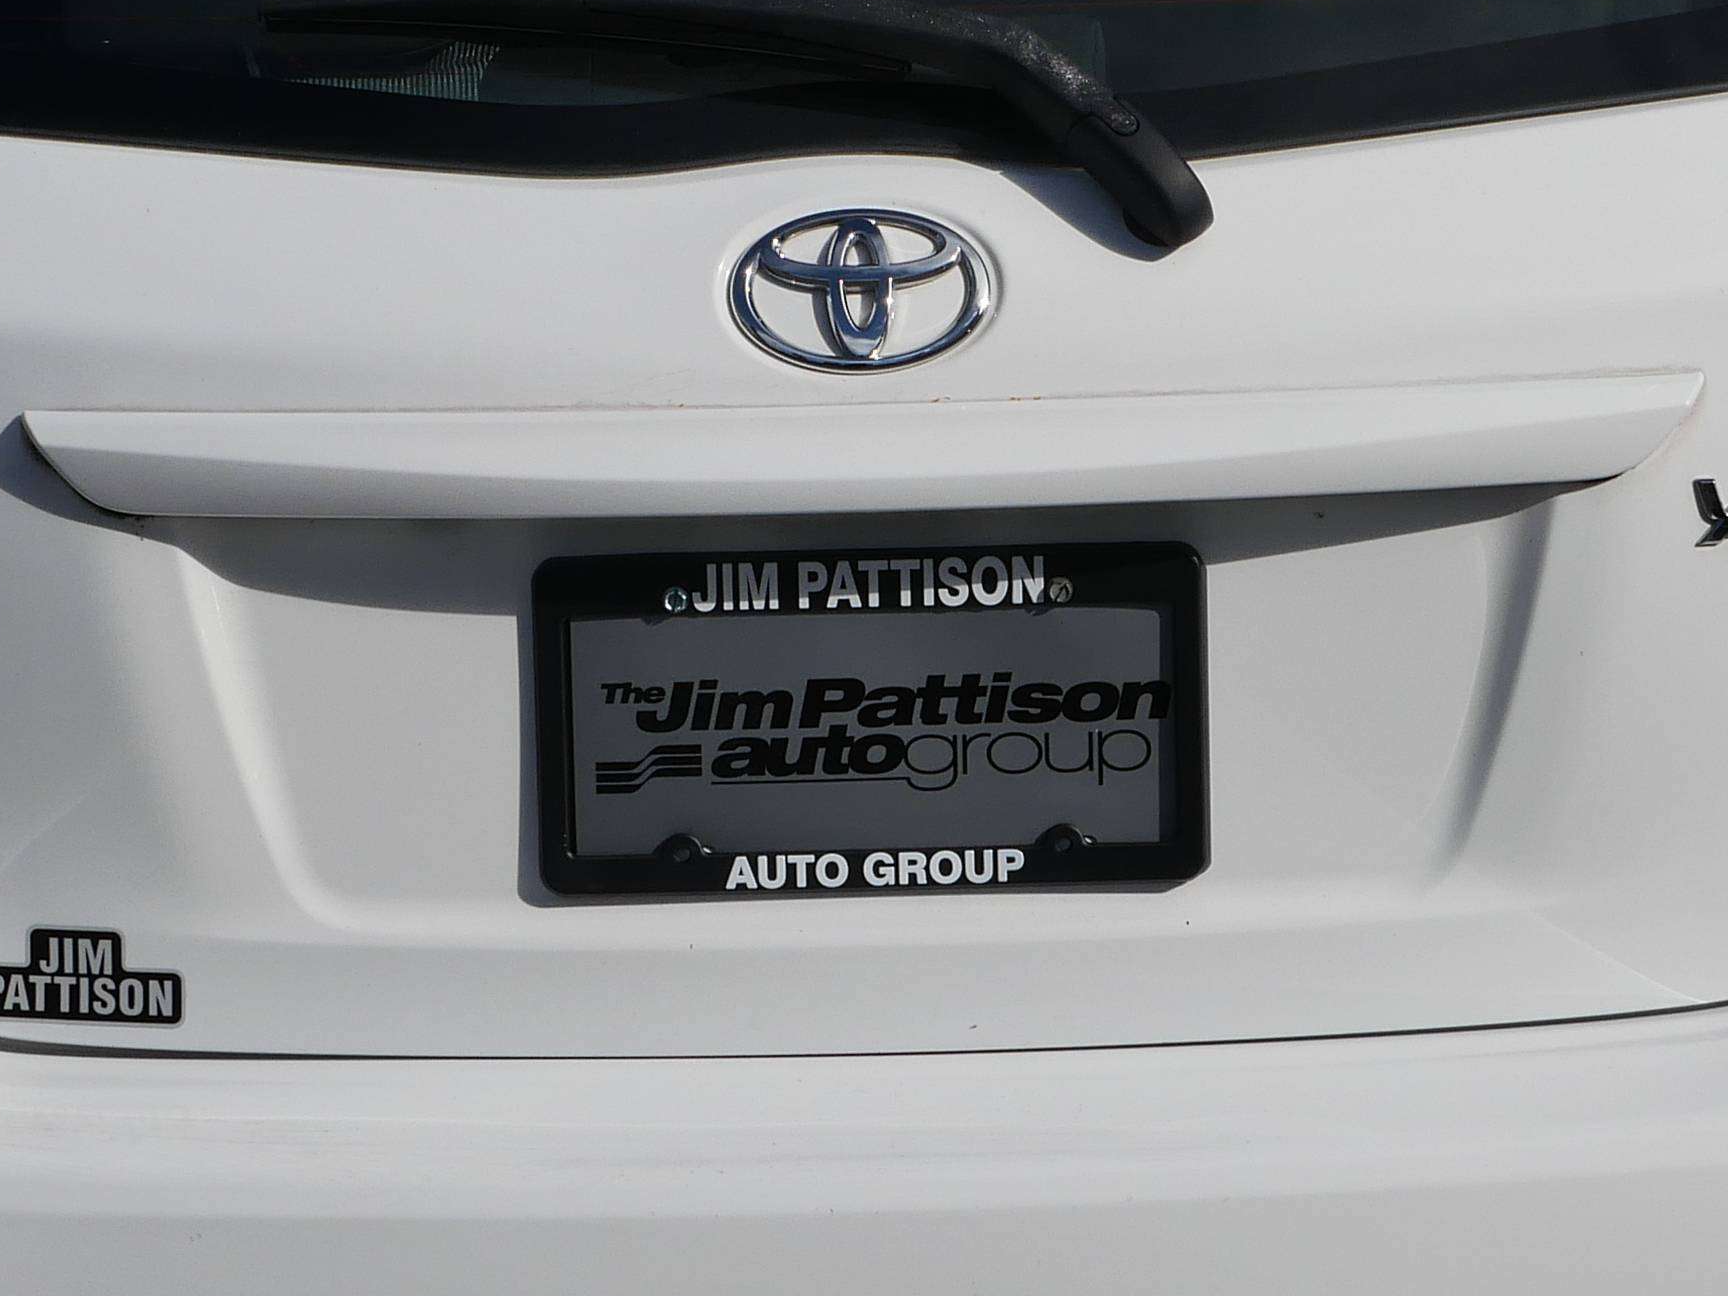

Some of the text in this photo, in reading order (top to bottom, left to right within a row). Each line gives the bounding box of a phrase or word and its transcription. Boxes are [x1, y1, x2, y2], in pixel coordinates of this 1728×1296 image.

[692, 555, 1045, 613] JIM PATTISON
[601, 671, 1172, 734] The Jim Pattison
[726, 849, 1026, 890] AUTO GROUP
[39, 937, 113, 976] JIM
